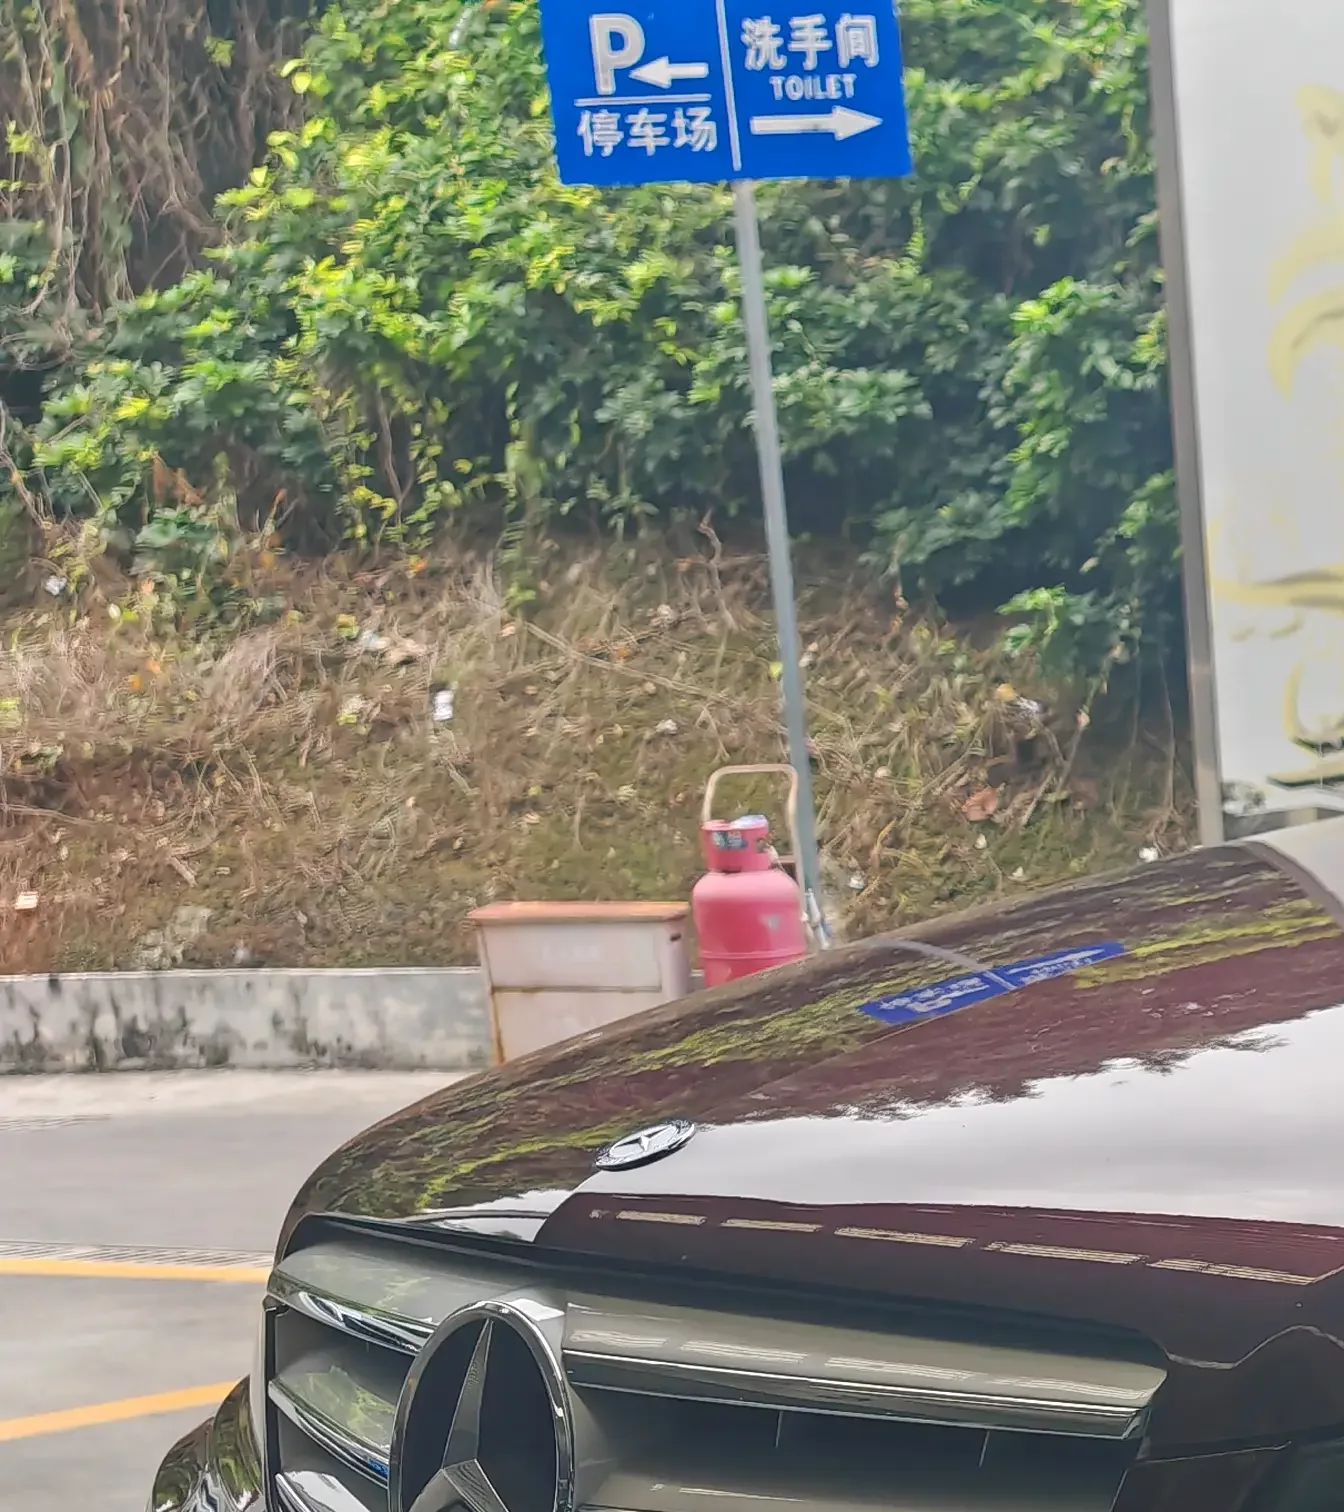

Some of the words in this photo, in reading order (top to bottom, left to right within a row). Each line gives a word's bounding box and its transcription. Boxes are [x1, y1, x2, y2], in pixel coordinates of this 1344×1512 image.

[588, 13, 646, 96] P
[740, 13, 880, 71] 洗手间
[768, 73, 858, 101] TOILET
[576, 106, 718, 157] 停车场
